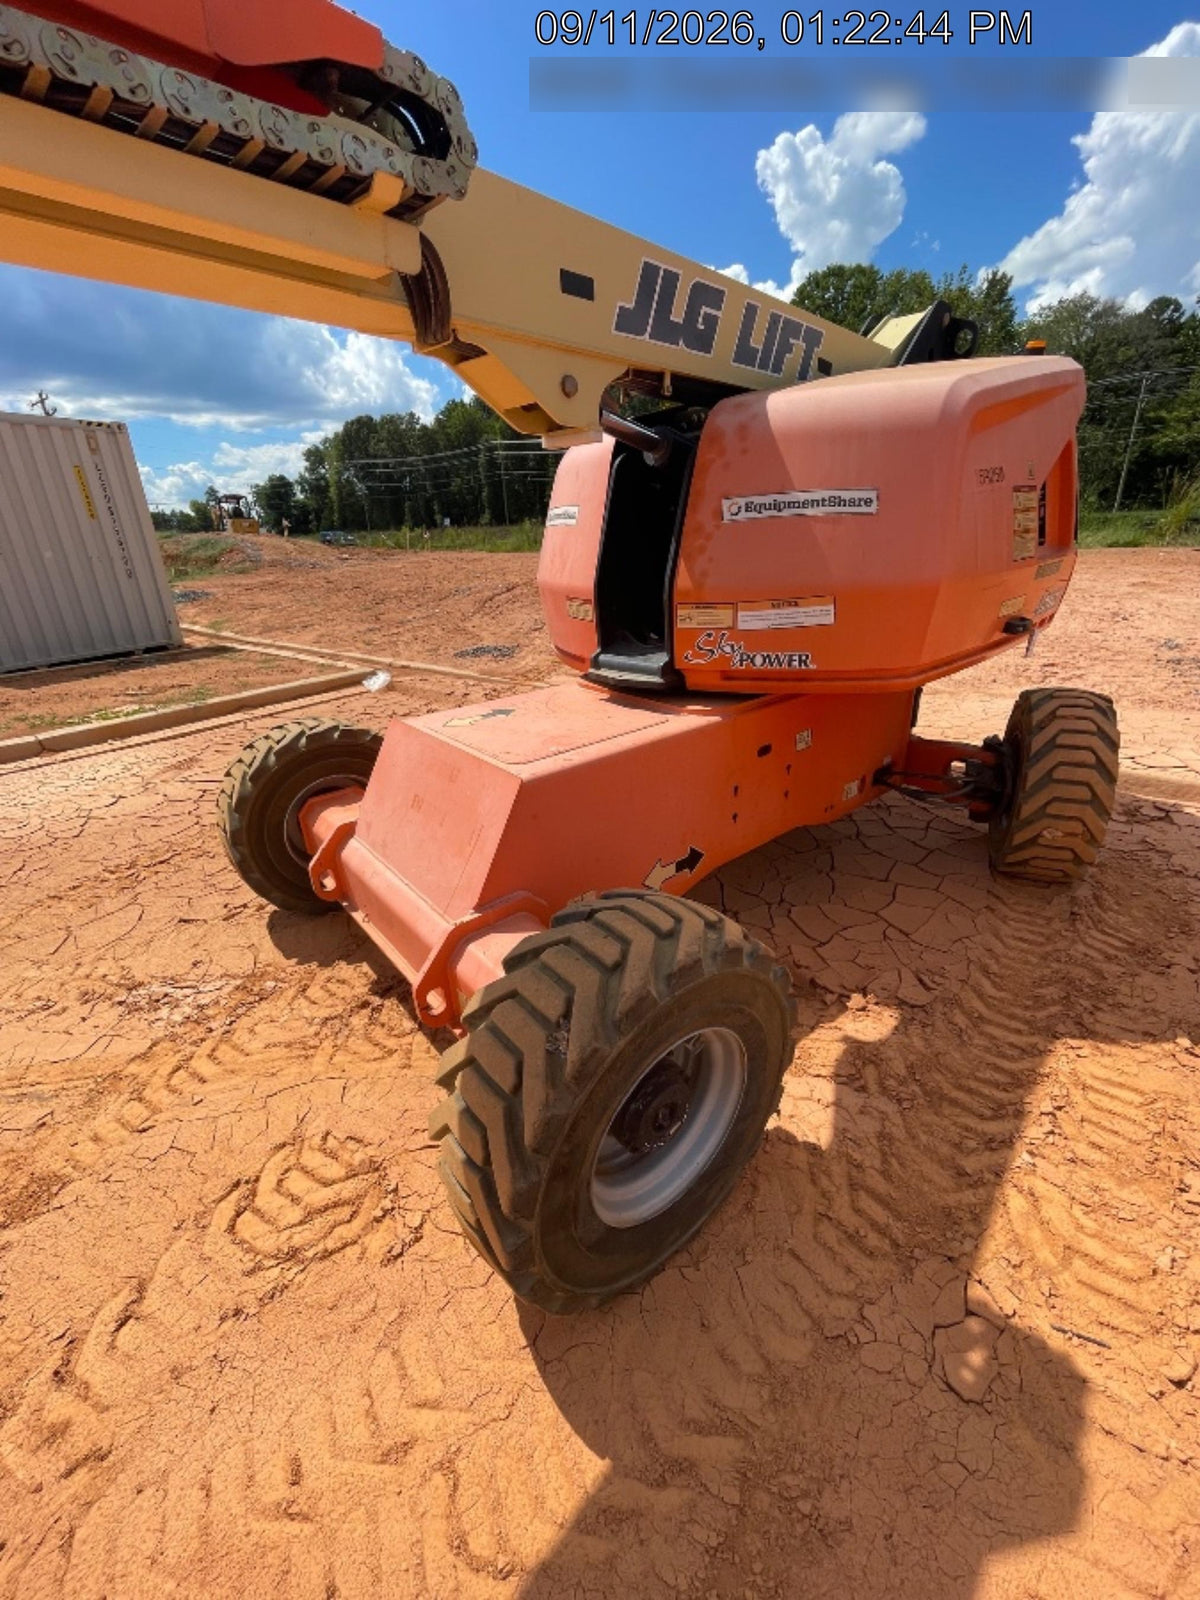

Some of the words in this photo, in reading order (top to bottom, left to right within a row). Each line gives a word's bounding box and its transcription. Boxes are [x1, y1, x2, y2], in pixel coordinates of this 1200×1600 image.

[612, 256, 727, 358] JLG
[731, 299, 825, 382] LIFT
[744, 495, 874, 514] EquipmentShare
[737, 652, 812, 669] POWER
